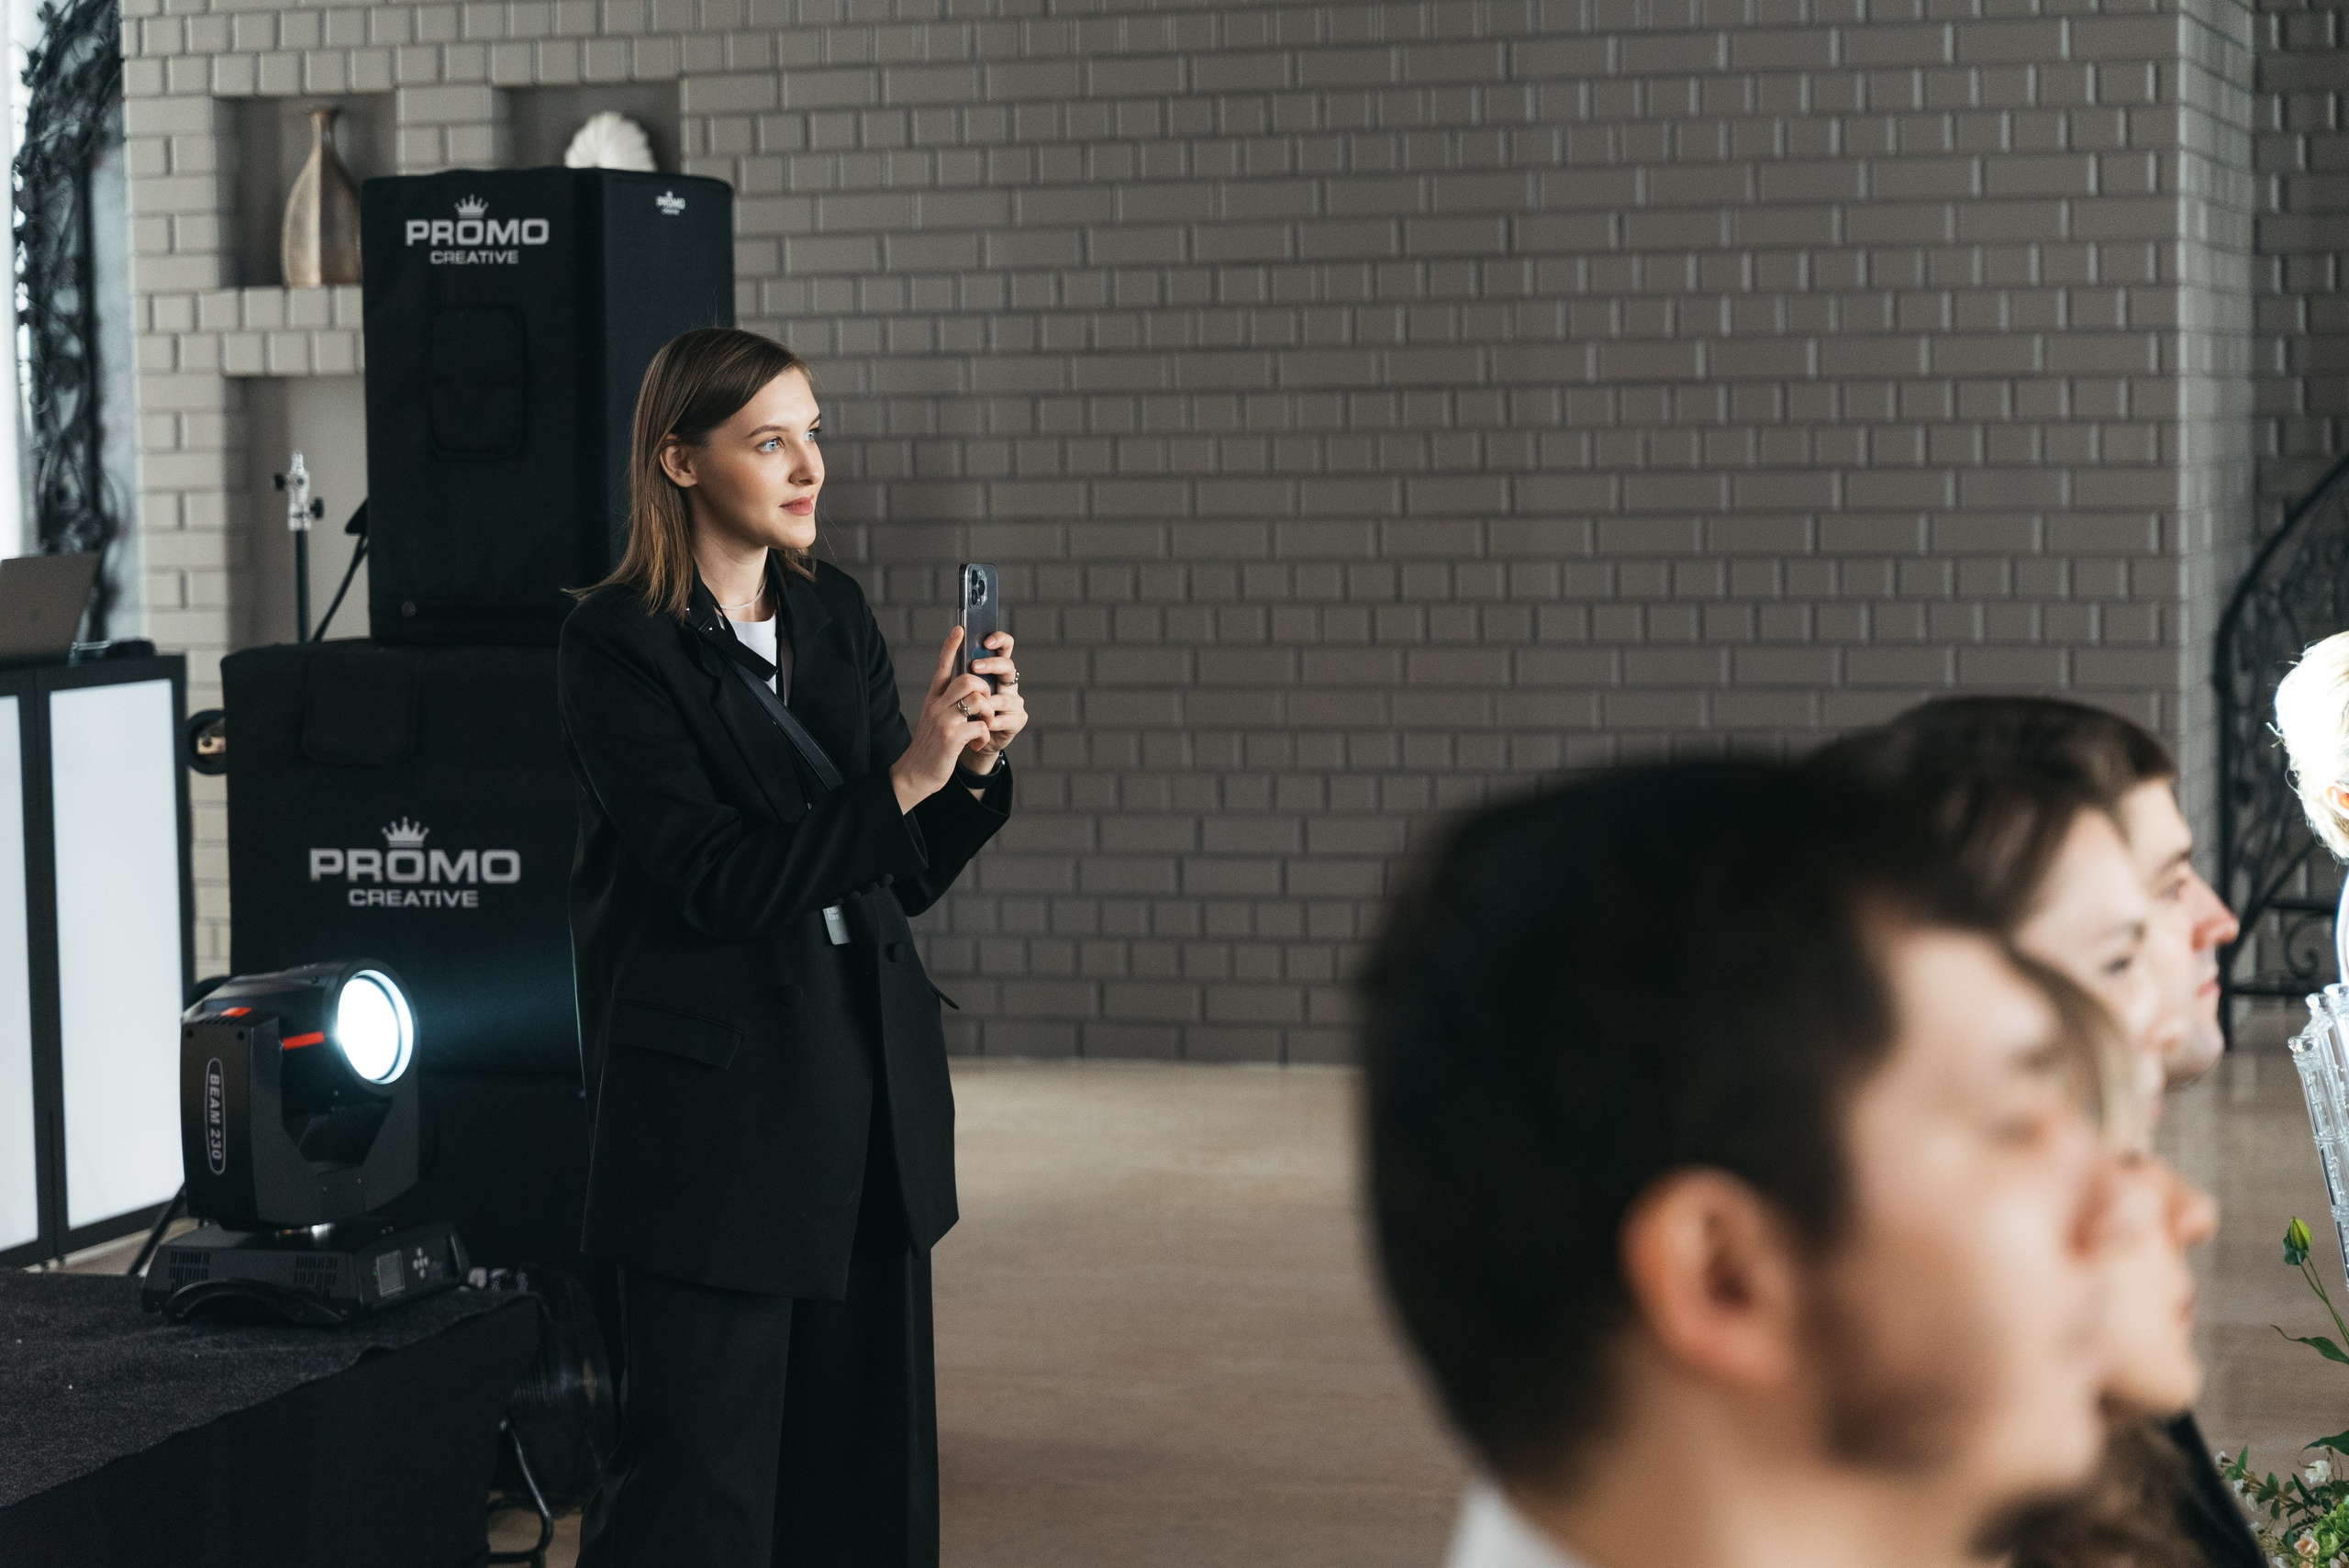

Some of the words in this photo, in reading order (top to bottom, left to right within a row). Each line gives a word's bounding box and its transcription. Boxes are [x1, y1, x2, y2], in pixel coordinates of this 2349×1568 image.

[406, 218, 550, 246] PROMO
[429, 250, 519, 264] CREATIVE
[309, 848, 521, 884] PROMO
[348, 888, 479, 907] CREATIVE
[209, 1073, 221, 1125] BEAM
[210, 1127, 222, 1160] 230
